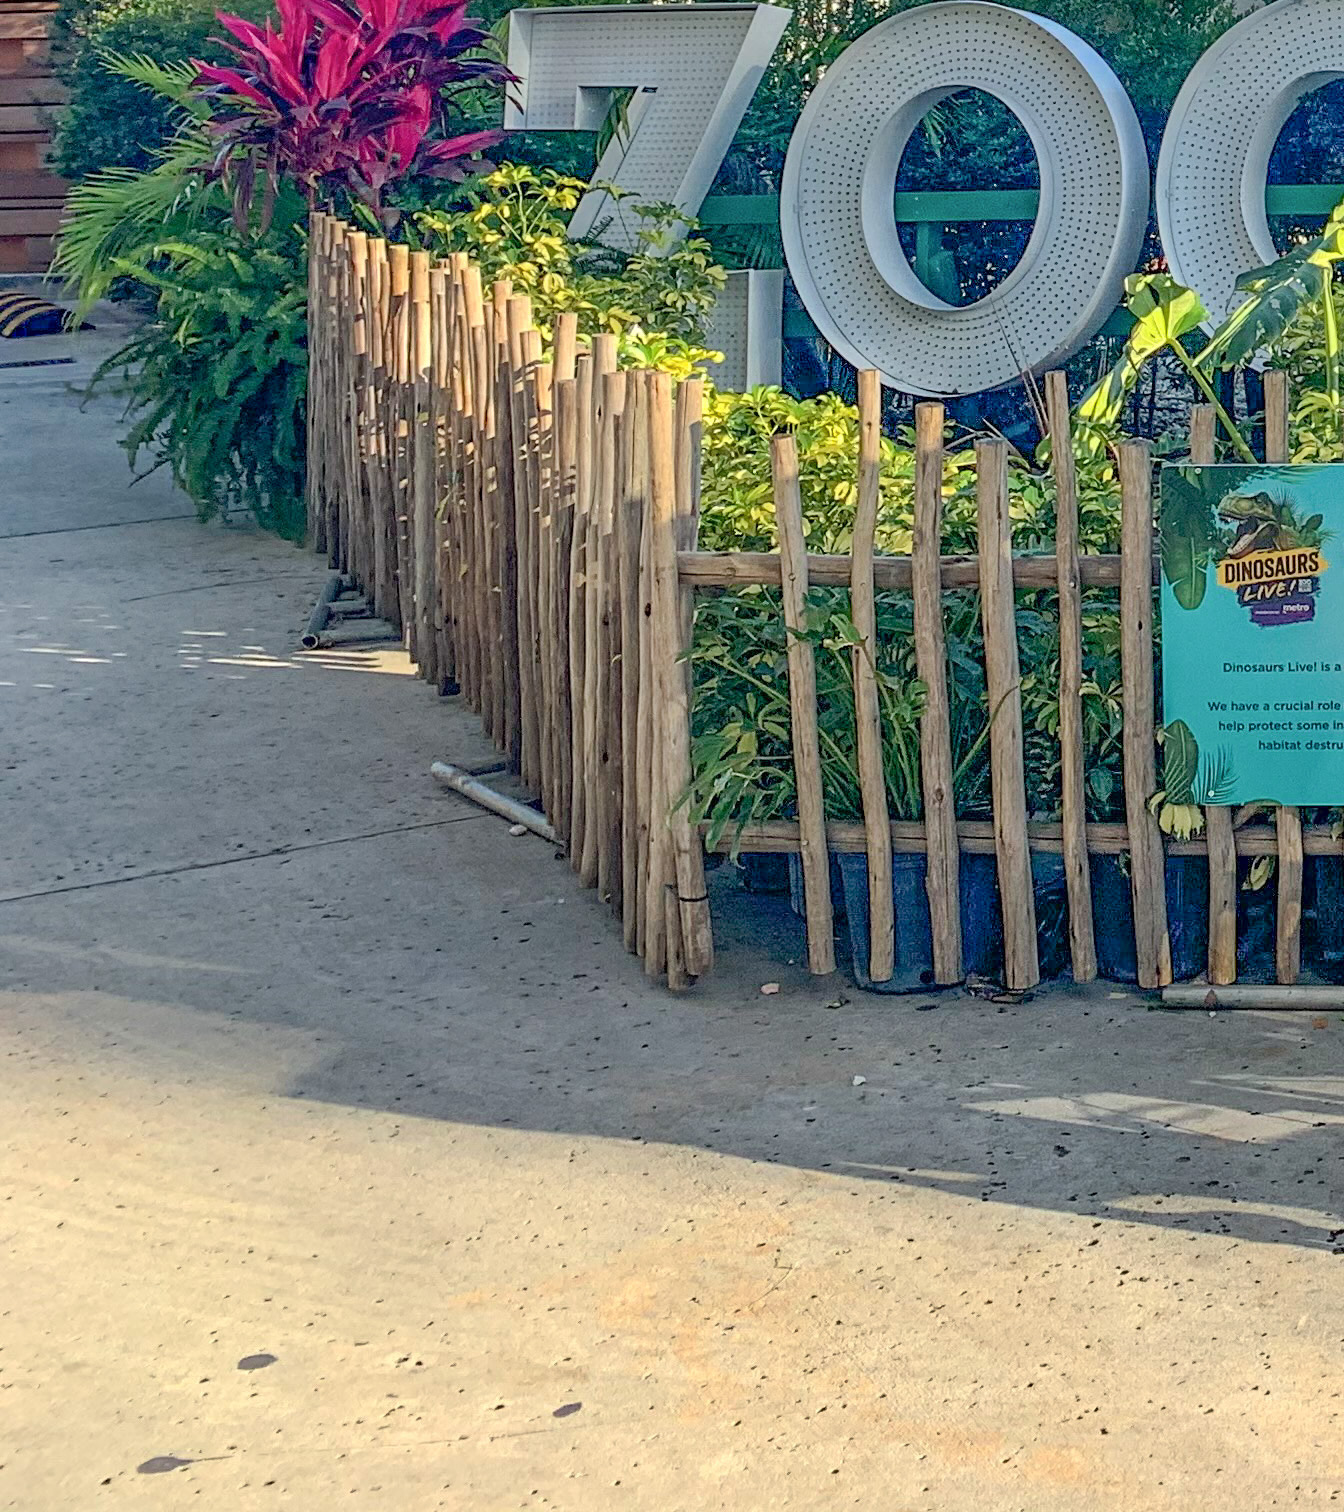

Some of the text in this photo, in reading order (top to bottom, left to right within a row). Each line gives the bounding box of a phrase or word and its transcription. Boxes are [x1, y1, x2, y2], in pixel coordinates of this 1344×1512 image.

[1225, 551, 1319, 584] DINOSAURS
[1243, 579, 1297, 602] LIVE!
[1282, 603, 1310, 614] metro
[1223, 662, 1284, 673] Dinosaurs
[1288, 661, 1317, 672] Live!
[1321, 661, 1330, 672] is
[1334, 664, 1342, 672] a
[1207, 701, 1227, 711] We
[1231, 701, 1259, 711] have
[1263, 703, 1270, 711] a
[1273, 701, 1313, 711] crucial
[1317, 700, 1340, 711] role
[1218, 721, 1244, 732] help
[1249, 721, 1293, 732] protect
[1297, 722, 1329, 730] some
[1258, 740, 1301, 751] habitat
